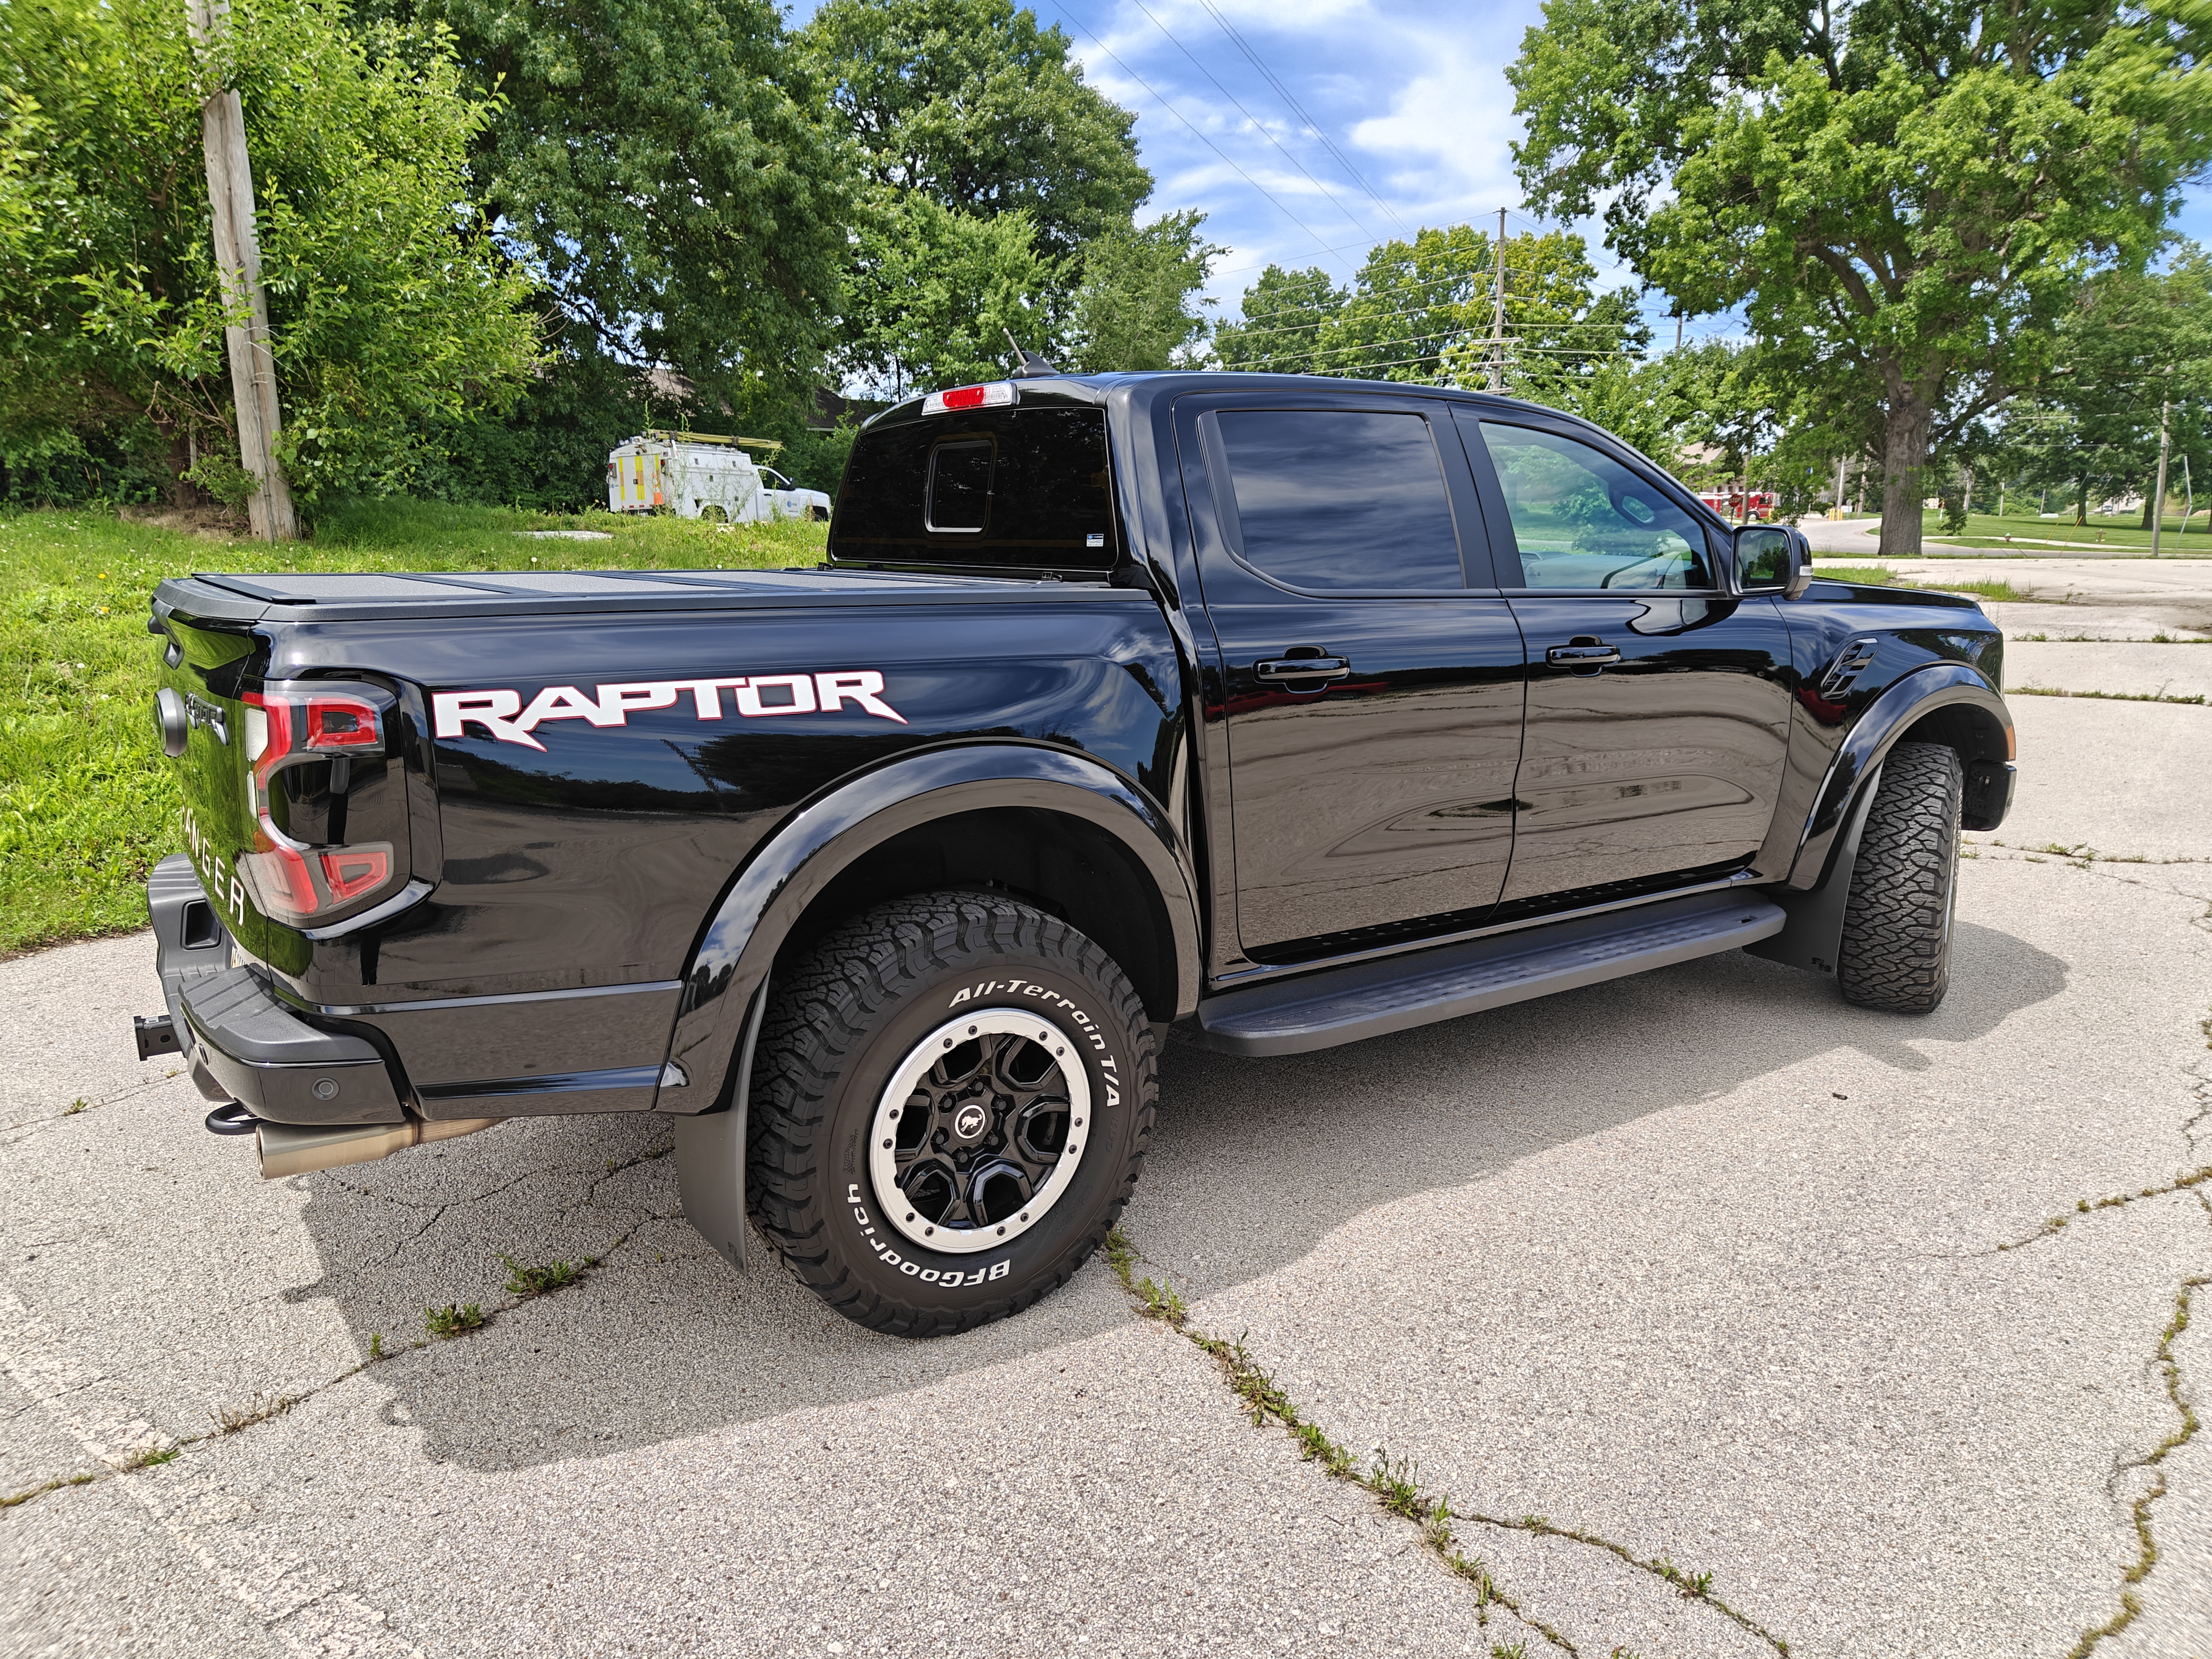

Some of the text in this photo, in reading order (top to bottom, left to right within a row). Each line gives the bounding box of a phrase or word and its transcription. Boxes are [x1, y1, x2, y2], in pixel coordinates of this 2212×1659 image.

[432, 670, 908, 752] RAPTOR
[948, 980, 1106, 1050] All-Terrain
[1101, 1055, 1120, 1107] T/A
[847, 1183, 1011, 1287] BFGoodrich
